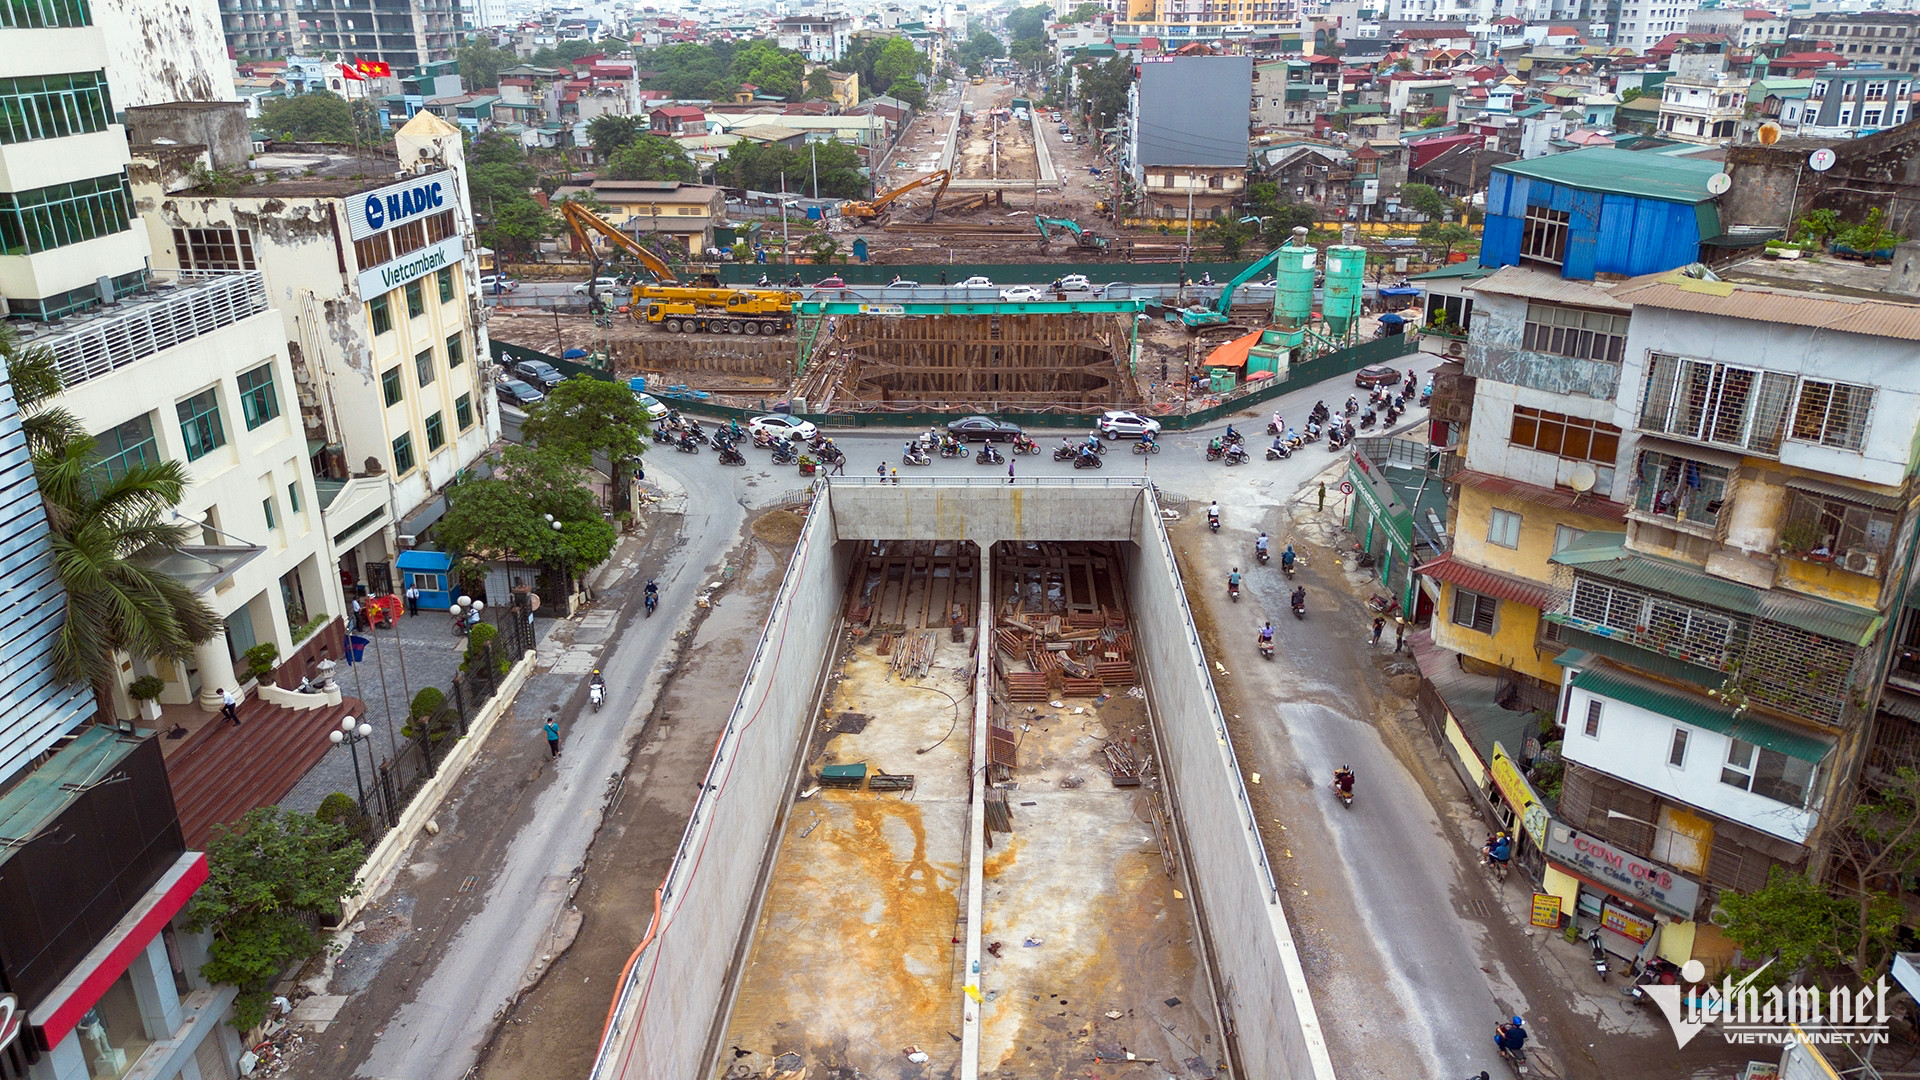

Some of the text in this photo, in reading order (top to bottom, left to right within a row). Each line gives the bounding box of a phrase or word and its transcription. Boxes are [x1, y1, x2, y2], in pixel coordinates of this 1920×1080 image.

[387, 182, 443, 222] HADIC
[381, 247, 446, 288] Vietcombank
[1573, 837, 1625, 868] CƠM
[1628, 862, 1673, 890] QUÊ
